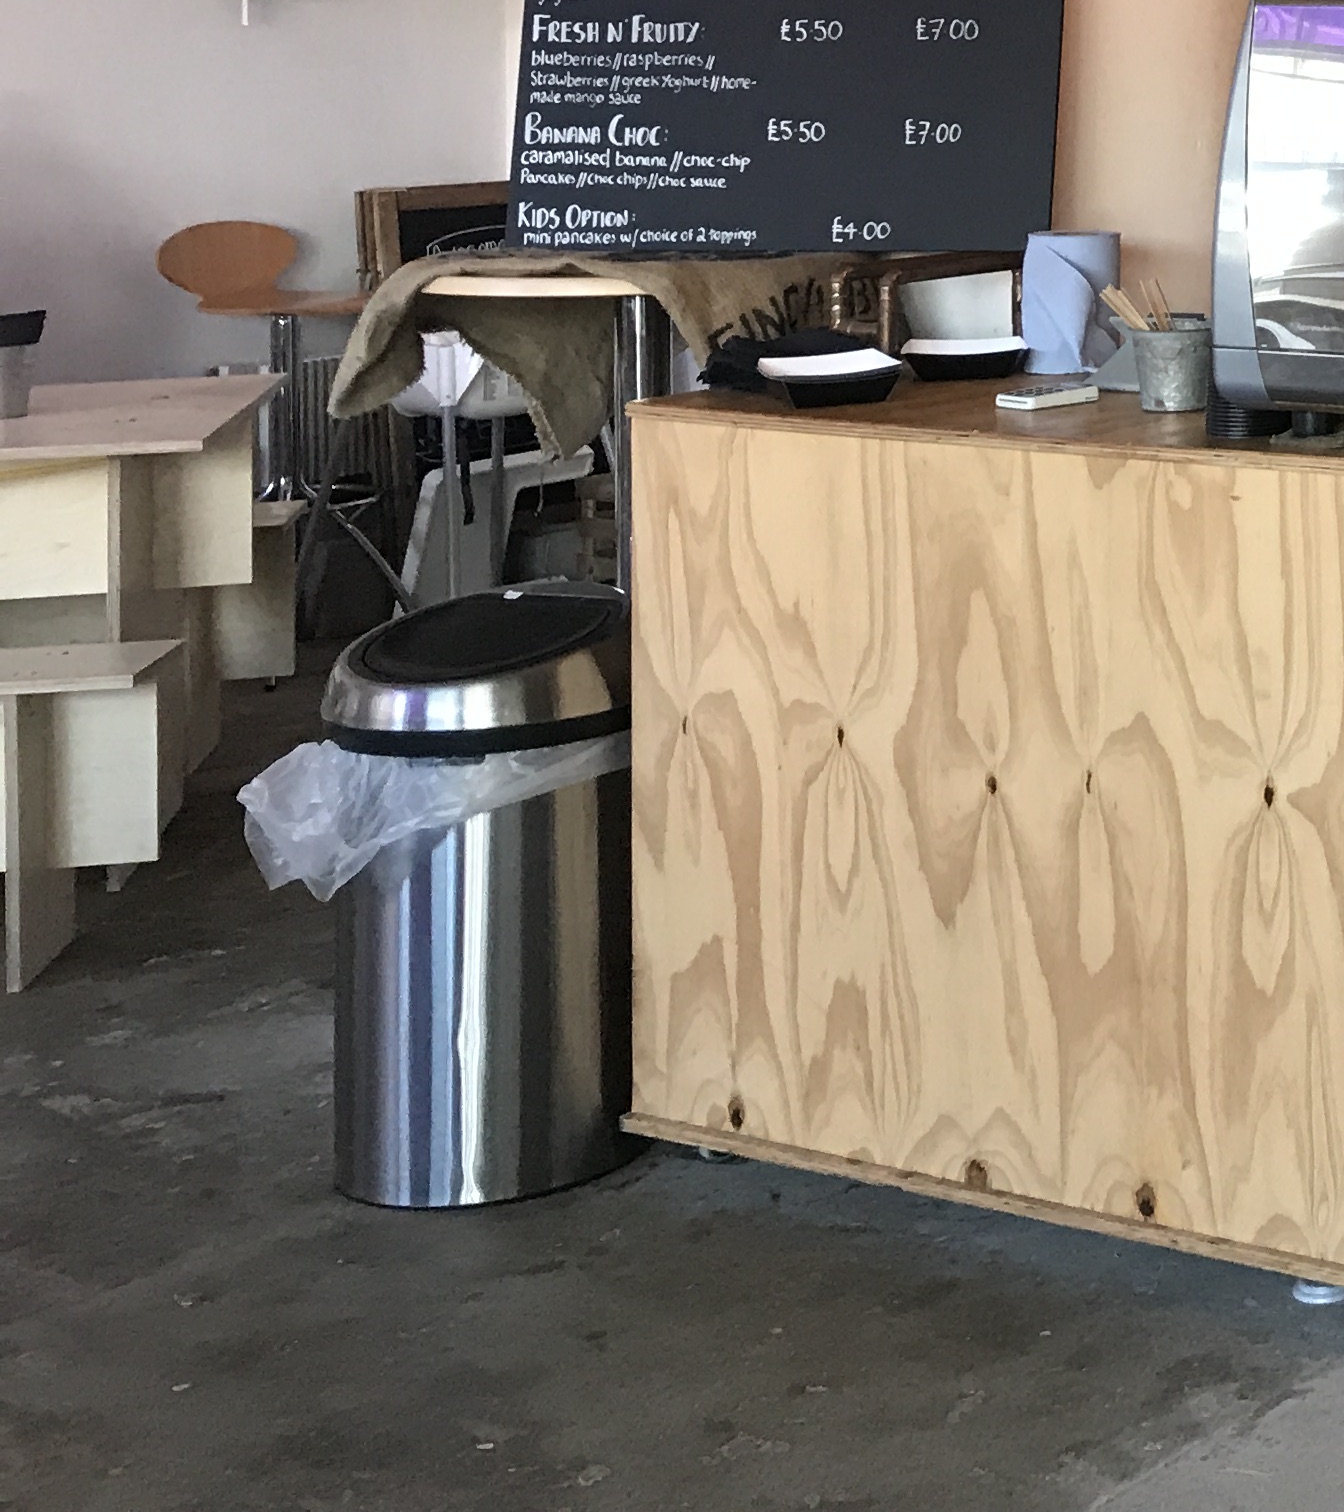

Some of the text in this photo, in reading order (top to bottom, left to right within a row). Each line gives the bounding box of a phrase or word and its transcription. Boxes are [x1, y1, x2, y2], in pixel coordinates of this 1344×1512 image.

[532, 14, 599, 43] FRESH
[530, 90, 641, 108] made mango sauce
[524, 111, 601, 145] BANANA
[520, 148, 610, 168] caramalised
[615, 150, 667, 167] banana
[690, 176, 727, 189] sauce
[517, 201, 560, 229] KIDS
[523, 231, 551, 245] mini
[554, 231, 616, 247] pancakes
[680, 229, 693, 242] of
[696, 227, 707, 241] 2
[708, 228, 757, 246] toppings
